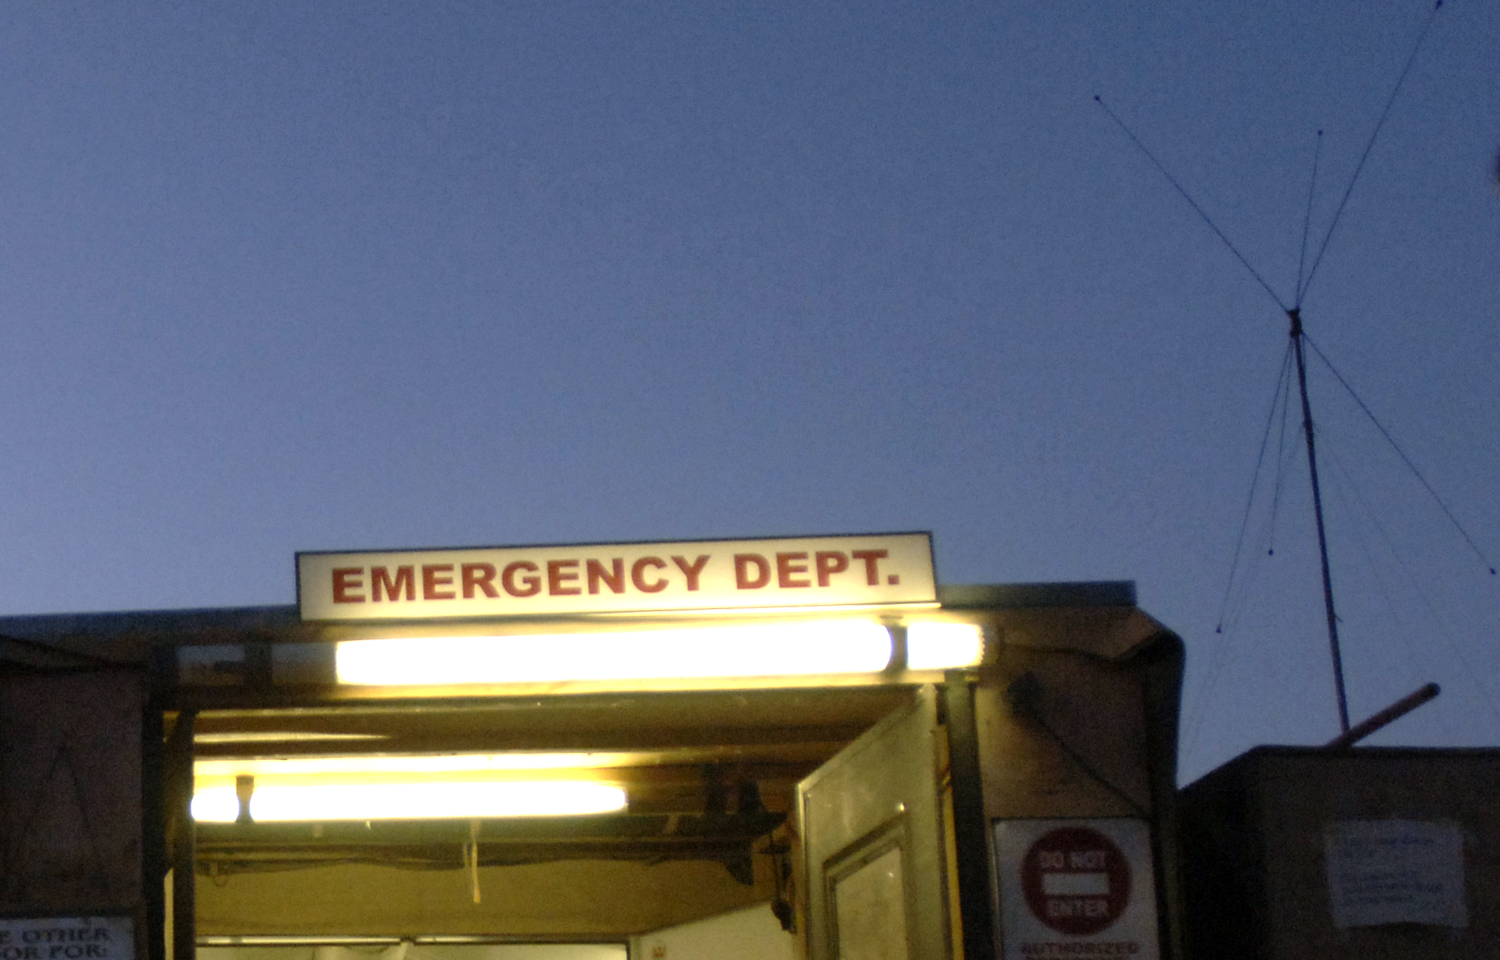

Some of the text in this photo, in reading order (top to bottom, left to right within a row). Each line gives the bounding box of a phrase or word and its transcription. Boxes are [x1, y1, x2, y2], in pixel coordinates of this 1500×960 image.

[331, 549, 900, 603] EMERGENCY DEPT.
[22, 927, 111, 944] OTHER
[48, 944, 108, 959] FOR:
